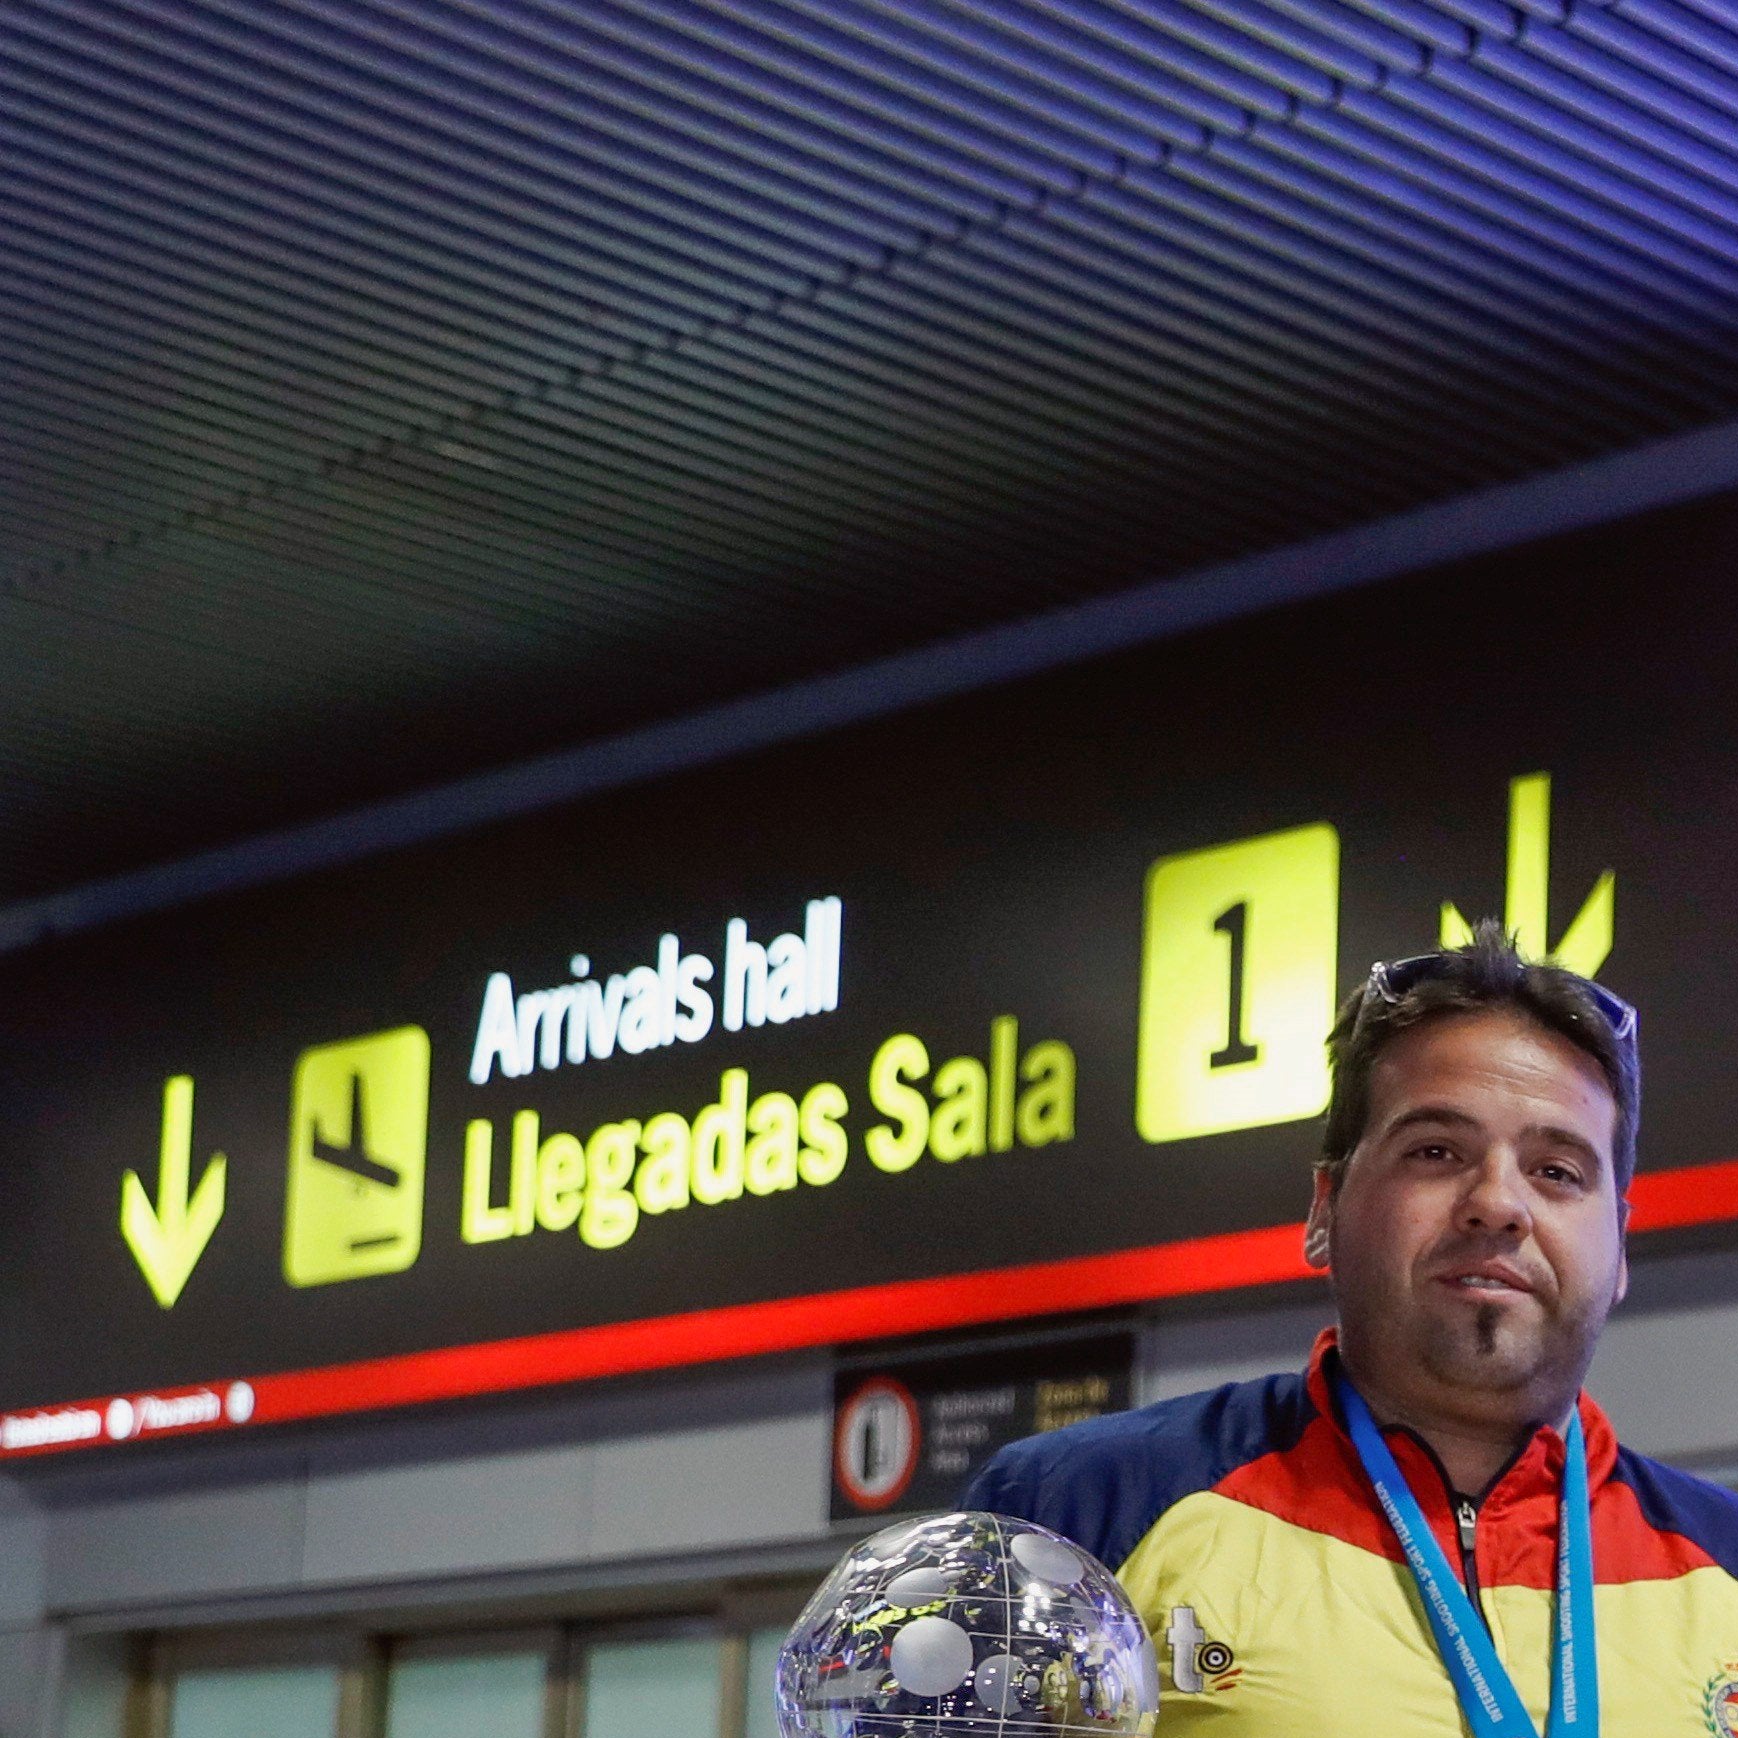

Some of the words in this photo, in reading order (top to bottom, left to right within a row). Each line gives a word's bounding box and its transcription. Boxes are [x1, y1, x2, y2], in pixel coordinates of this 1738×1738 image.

[470, 934, 714, 1085] Arrivals
[724, 896, 843, 1031] hall
[1210, 902, 1266, 1070] 1
[461, 1067, 849, 1250] Llegadas
[865, 1015, 1076, 1174] Sala
[1407, 1543, 1433, 1582] SPORT
[1425, 1579, 1460, 1637] SHOOTING
[1454, 1636, 1504, 1723] INTERNATIONAL
